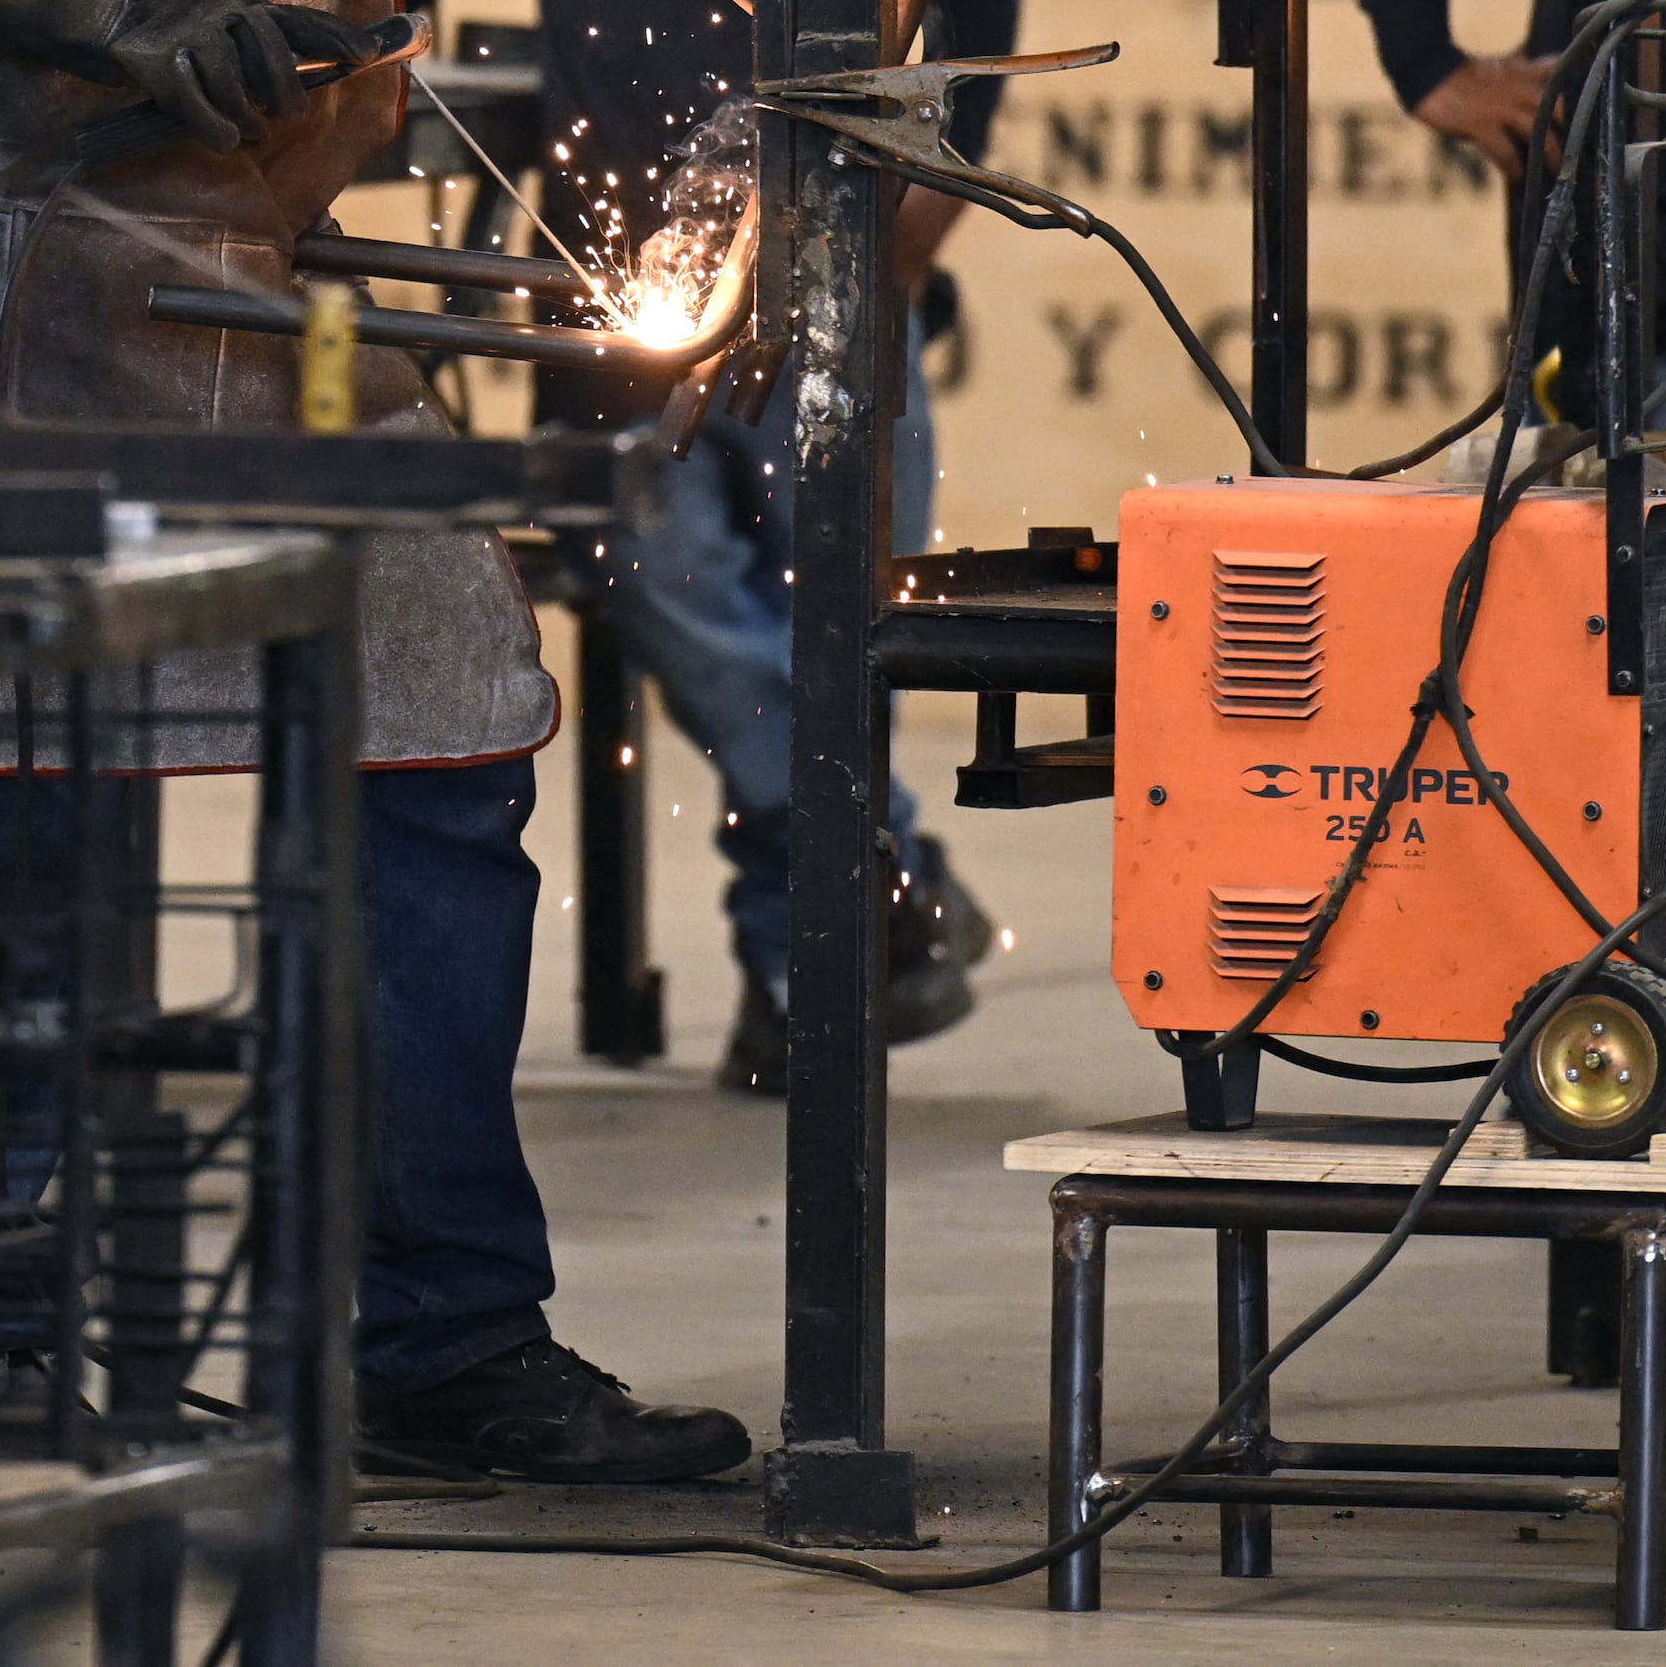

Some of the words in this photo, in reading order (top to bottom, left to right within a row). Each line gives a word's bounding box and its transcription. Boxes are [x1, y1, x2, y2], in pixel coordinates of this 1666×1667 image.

[1044, 300, 1125, 398] Y
[1310, 765, 1510, 806] TRUPER
[1403, 817, 1426, 844] A
